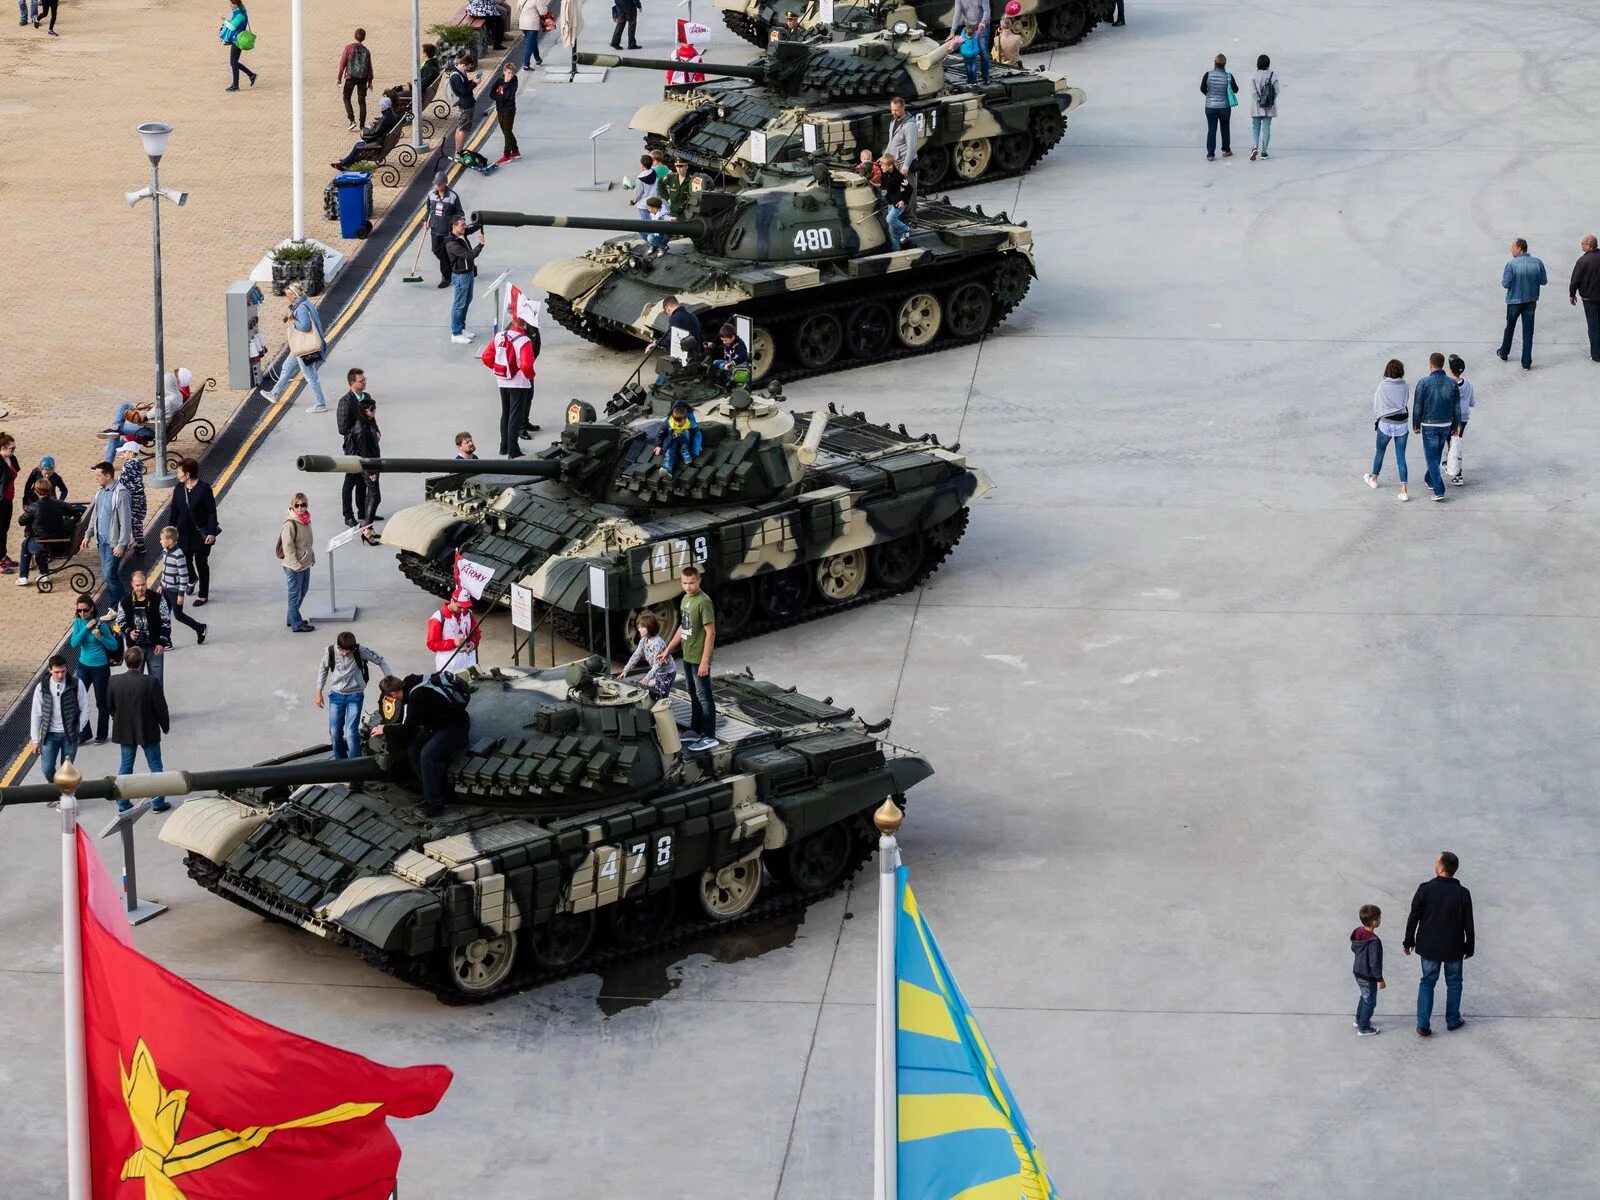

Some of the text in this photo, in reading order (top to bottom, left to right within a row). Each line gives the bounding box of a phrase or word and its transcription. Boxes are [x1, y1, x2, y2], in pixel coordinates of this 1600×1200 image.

[793, 227, 833, 251] 480
[654, 536, 708, 572] 479
[601, 835, 672, 880] 478
